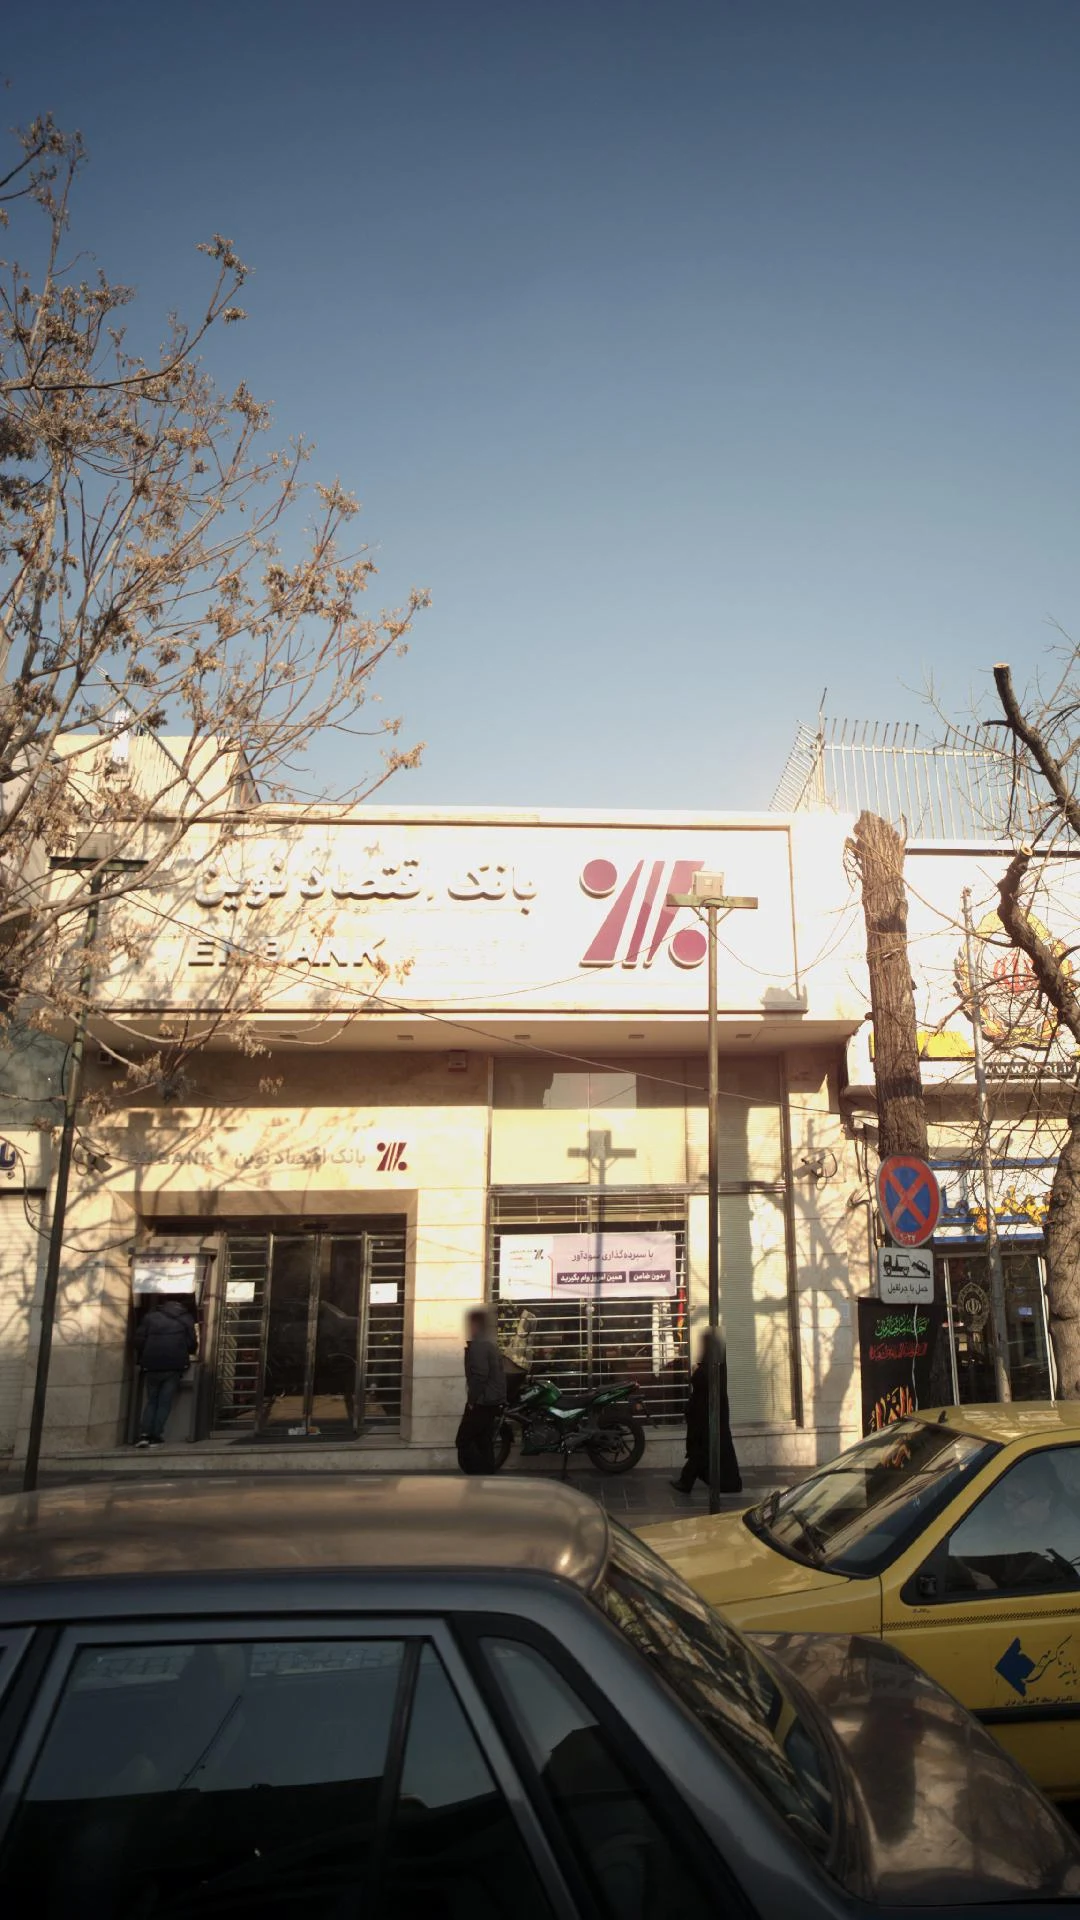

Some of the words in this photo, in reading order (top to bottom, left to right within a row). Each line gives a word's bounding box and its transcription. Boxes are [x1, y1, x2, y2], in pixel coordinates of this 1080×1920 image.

[447, 862, 537, 916] بانک
[234, 1148, 270, 1169] نوین
[274, 1147, 326, 1167] اقتصاد
[331, 1149, 366, 1168] بانک
[560, 1274, 579, 1284] بگیرید
[606, 1273, 623, 1282] همین
[633, 1273, 650, 1282] ضامن
[651, 1273, 666, 1281] بدون
[888, 1283, 908, 1295] جرثقیل
[916, 1283, 928, 1295] حمل
